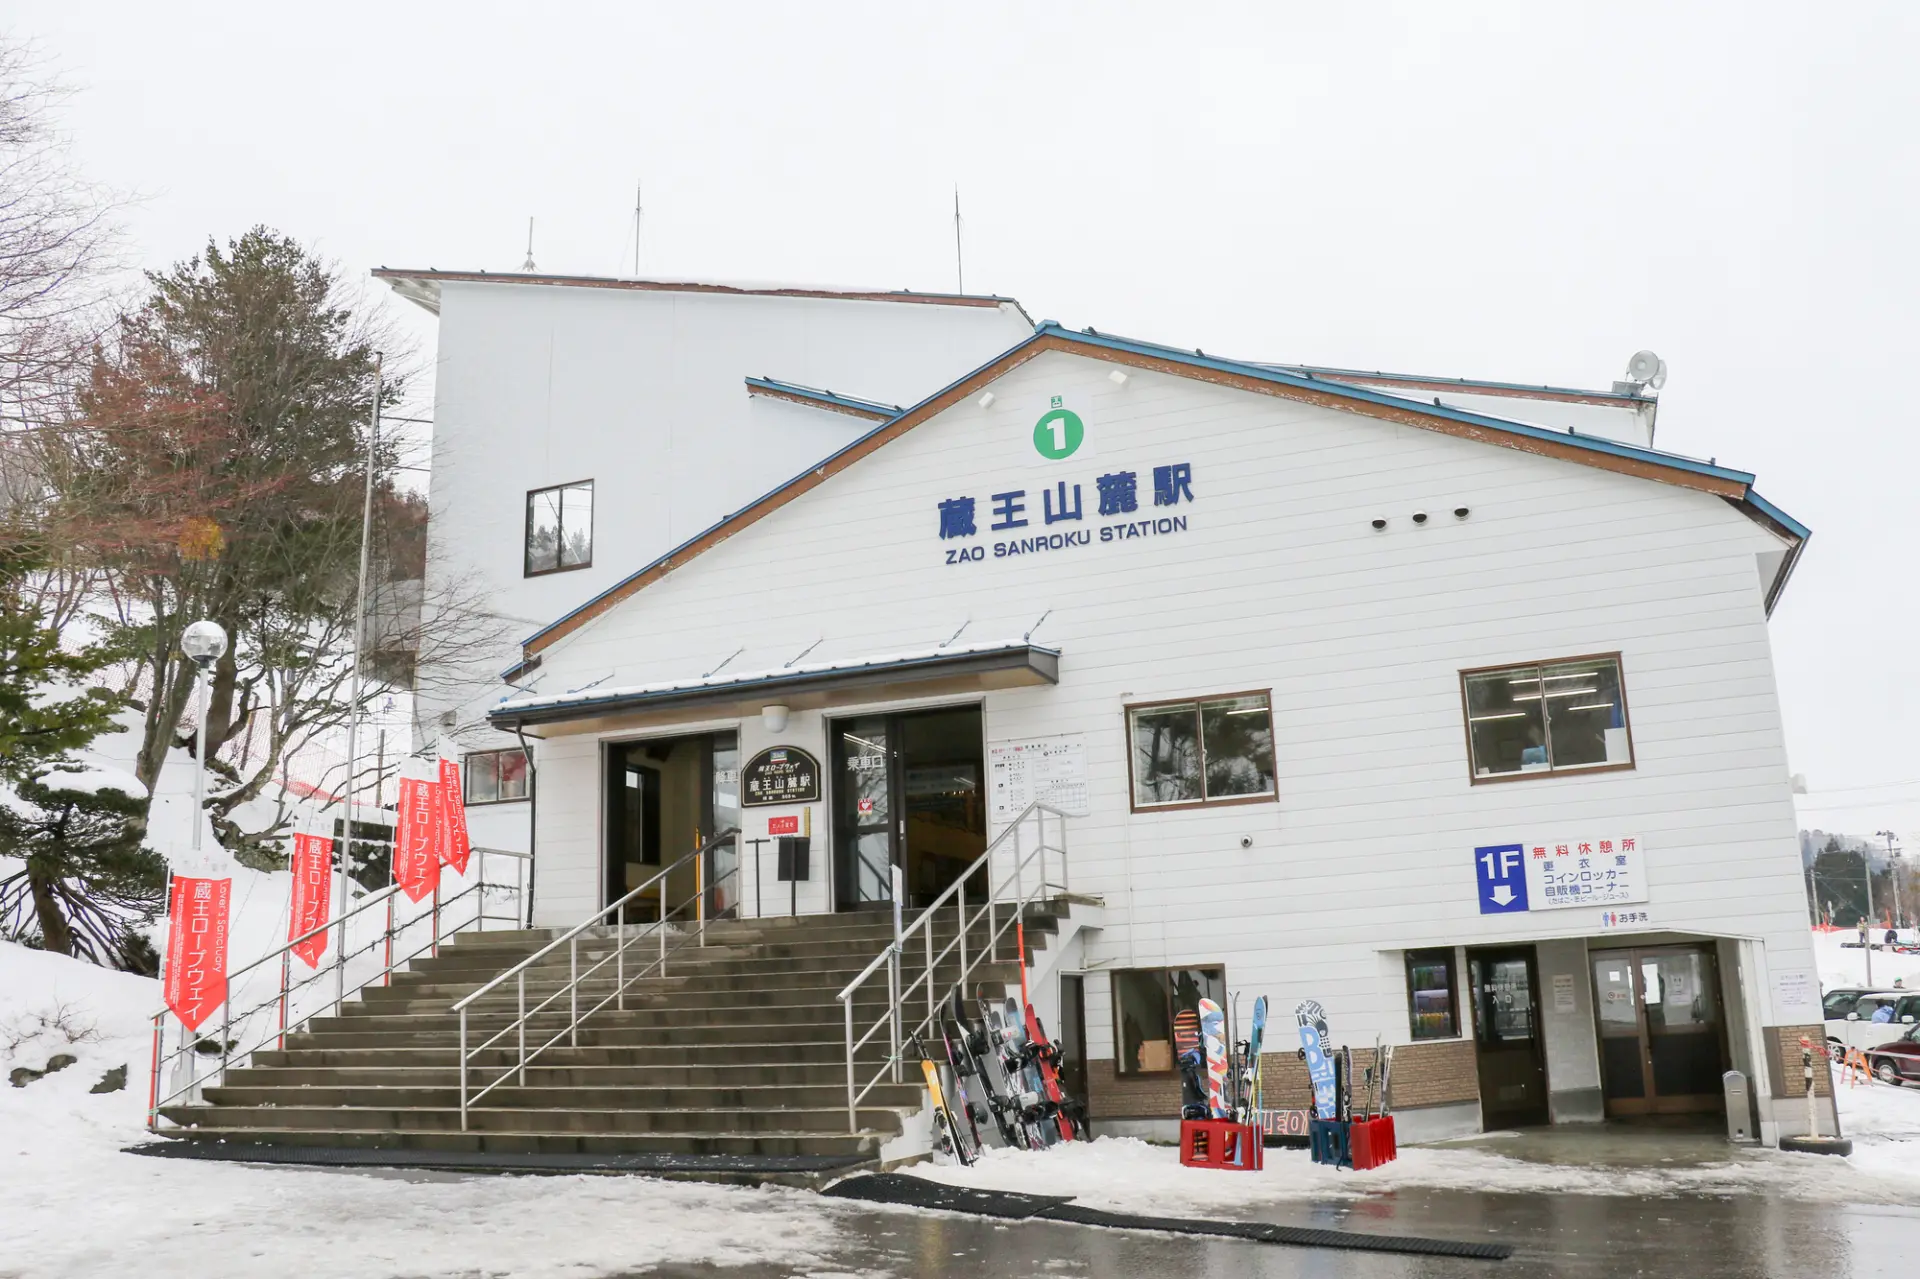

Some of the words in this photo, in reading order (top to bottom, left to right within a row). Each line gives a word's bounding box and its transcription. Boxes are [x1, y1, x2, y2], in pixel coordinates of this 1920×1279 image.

[1046, 417, 1067, 451] 1
[937, 462, 1194, 540] 蔵王山麓駅
[945, 546, 985, 565] ZAO
[993, 528, 1092, 558] SANROKU
[1099, 515, 1188, 542] STATION
[1479, 850, 1520, 880] 1F
[1532, 838, 1636, 860] 無料休憩所
[1543, 855, 1627, 873] 更衣室
[1543, 869, 1629, 885] コインロッカー
[1544, 881, 1630, 897] 自販機コーナー
[218, 881, 229, 916] Lover's
[1618, 911, 1649, 924] お手洗
[184, 881, 212, 1021] 蔵王ロープウェイ
[212, 919, 227, 974] Sanctuary
